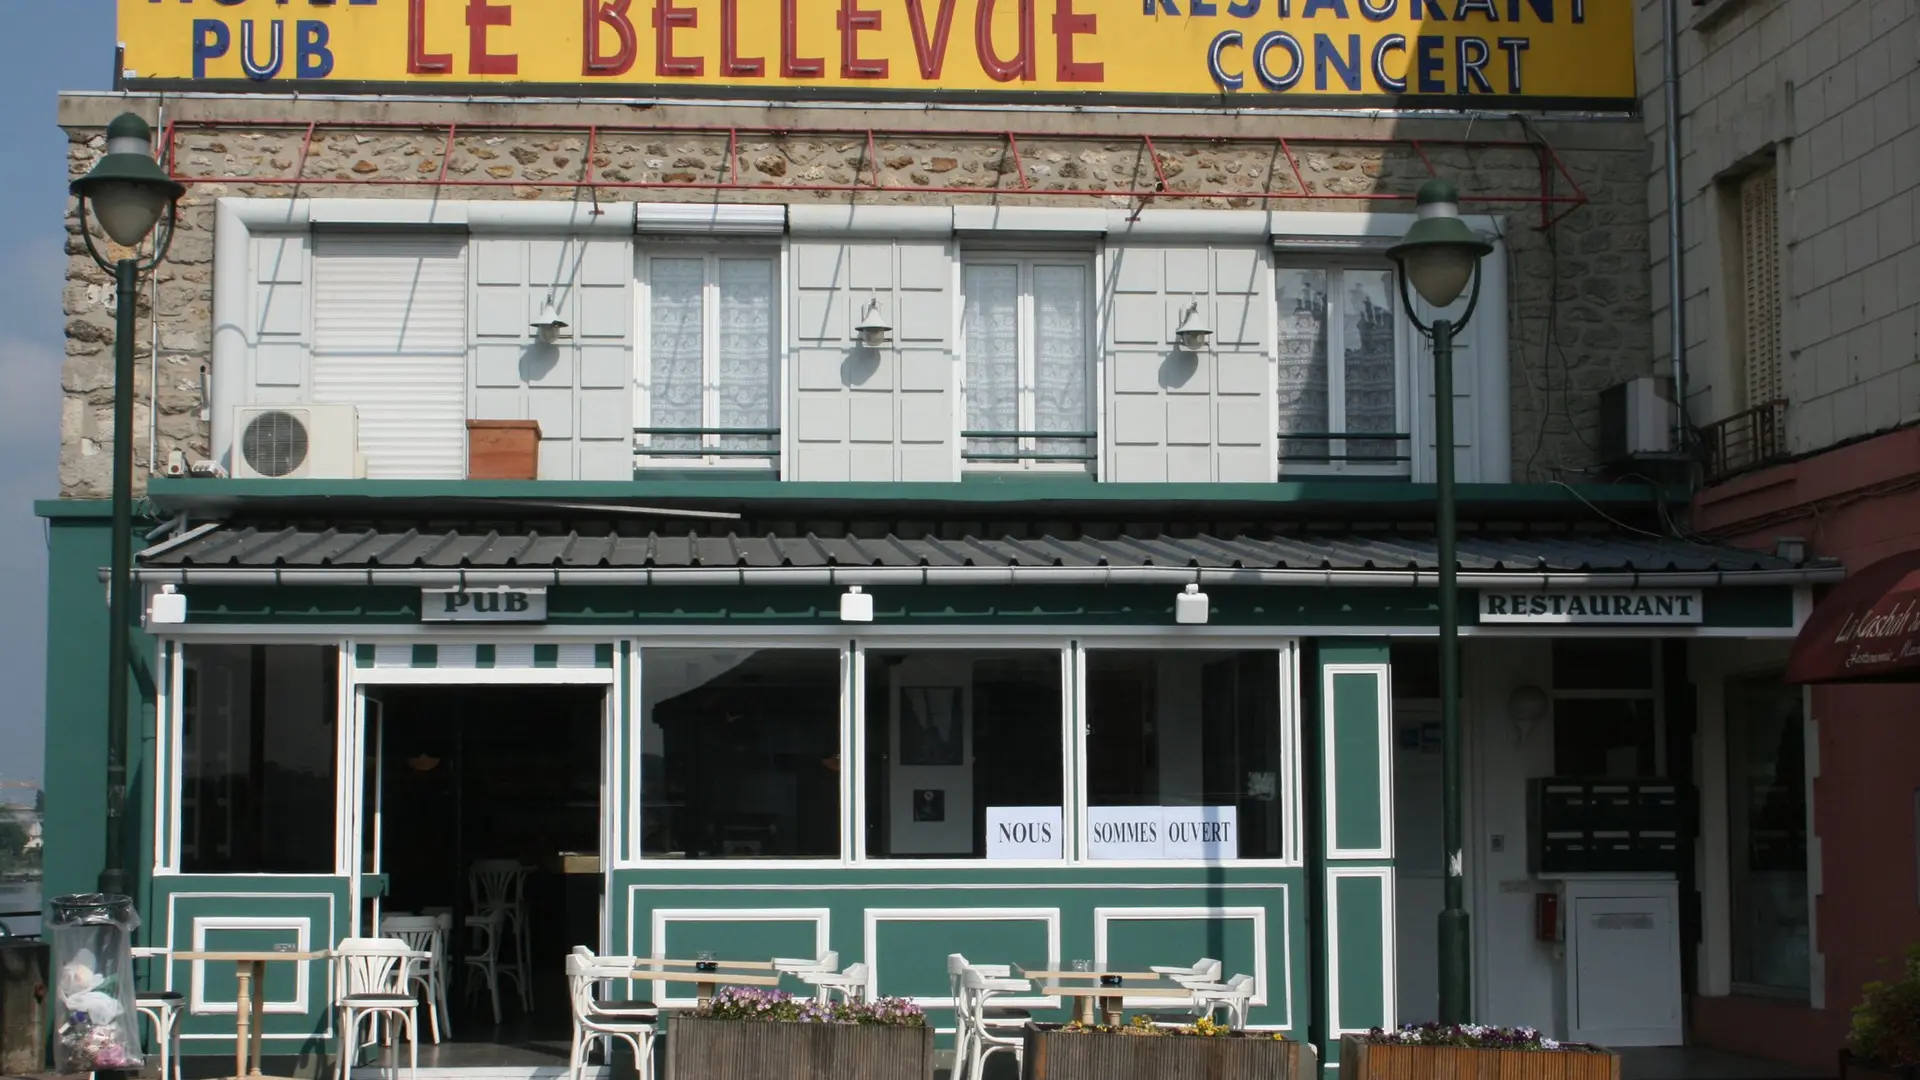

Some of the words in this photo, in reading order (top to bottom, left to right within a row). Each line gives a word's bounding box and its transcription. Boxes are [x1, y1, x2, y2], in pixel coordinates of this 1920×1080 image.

[192, 19, 334, 81] PUB
[407, 0, 518, 75] LE
[582, 0, 1104, 82] BELLEVUE
[1207, 29, 1530, 94] CONCERT
[443, 591, 530, 613] PUB
[1486, 593, 1693, 617] RESTAURANT
[998, 821, 1052, 844] NOUS
[1093, 821, 1158, 844] SOMMES
[1168, 821, 1231, 843] OUVERT
